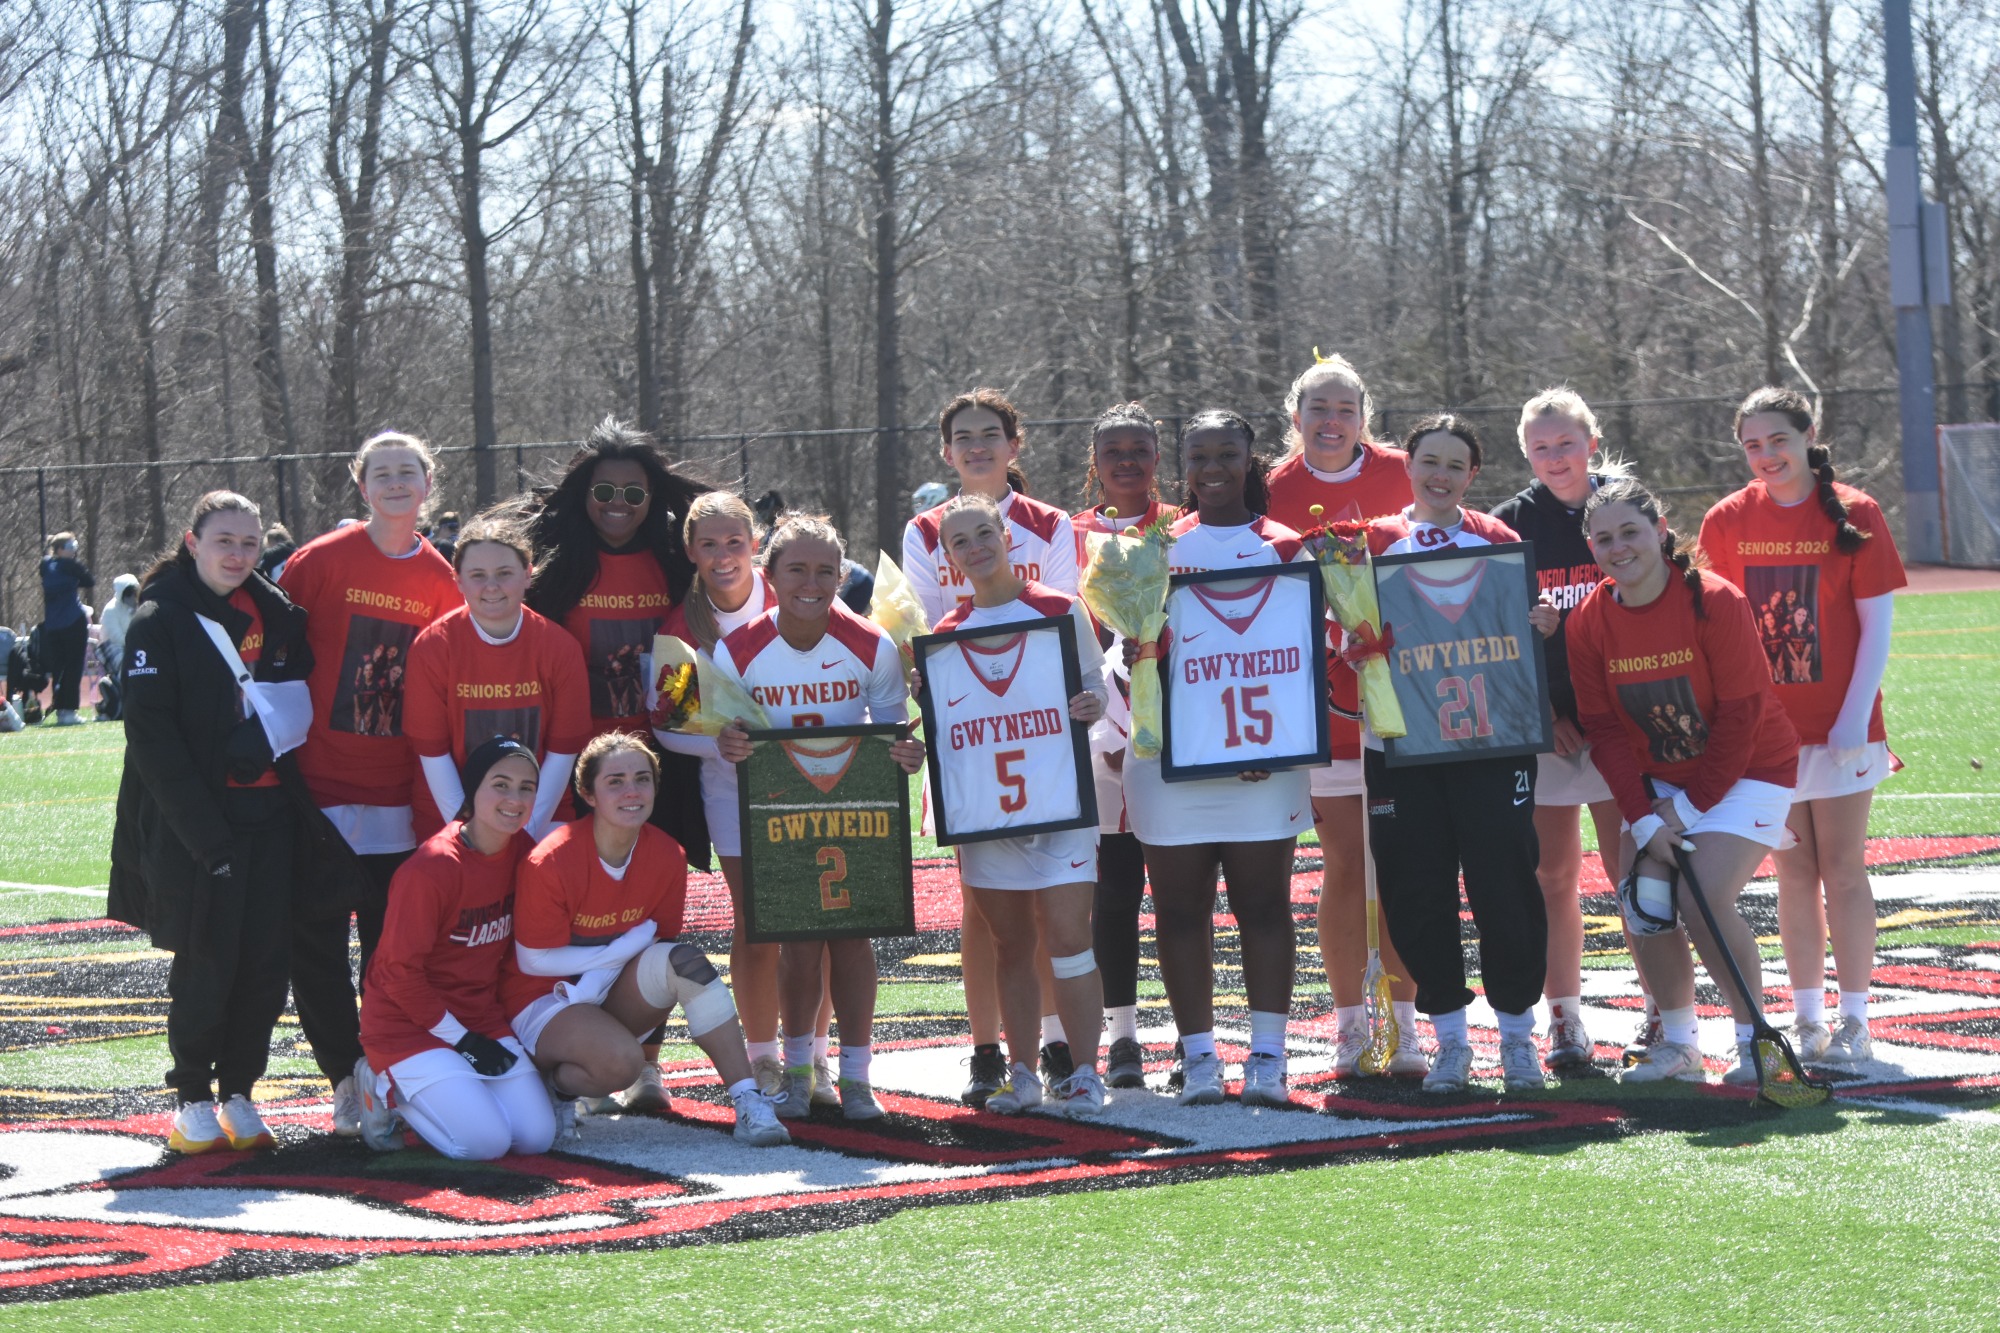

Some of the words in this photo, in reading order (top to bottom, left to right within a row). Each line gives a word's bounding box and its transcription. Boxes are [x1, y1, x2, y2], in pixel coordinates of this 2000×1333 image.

[1737, 541, 1792, 555] SENIORS
[1795, 540, 1830, 554] 2026
[1536, 567, 1566, 592] NEDD
[345, 588, 401, 611] SENIORS
[580, 594, 635, 609] SENIORS
[637, 593, 670, 608] 2026
[135, 650, 147, 668] 3
[1184, 646, 1300, 684] GWYNEDD
[1399, 636, 1520, 675] GWYNEDD
[1661, 648, 1693, 668] 2026
[456, 683, 511, 698] SENIORS
[752, 679, 860, 707] GWYNEDD
[1221, 684, 1273, 748] 15
[1436, 673, 1493, 741] 21
[950, 708, 1062, 751] GWYNEDD
[995, 748, 1027, 814] 5
[1515, 770, 1530, 792] 21
[767, 811, 889, 843] GWYNEDD
[816, 847, 851, 911] 2
[461, 1051, 478, 1064] STX
